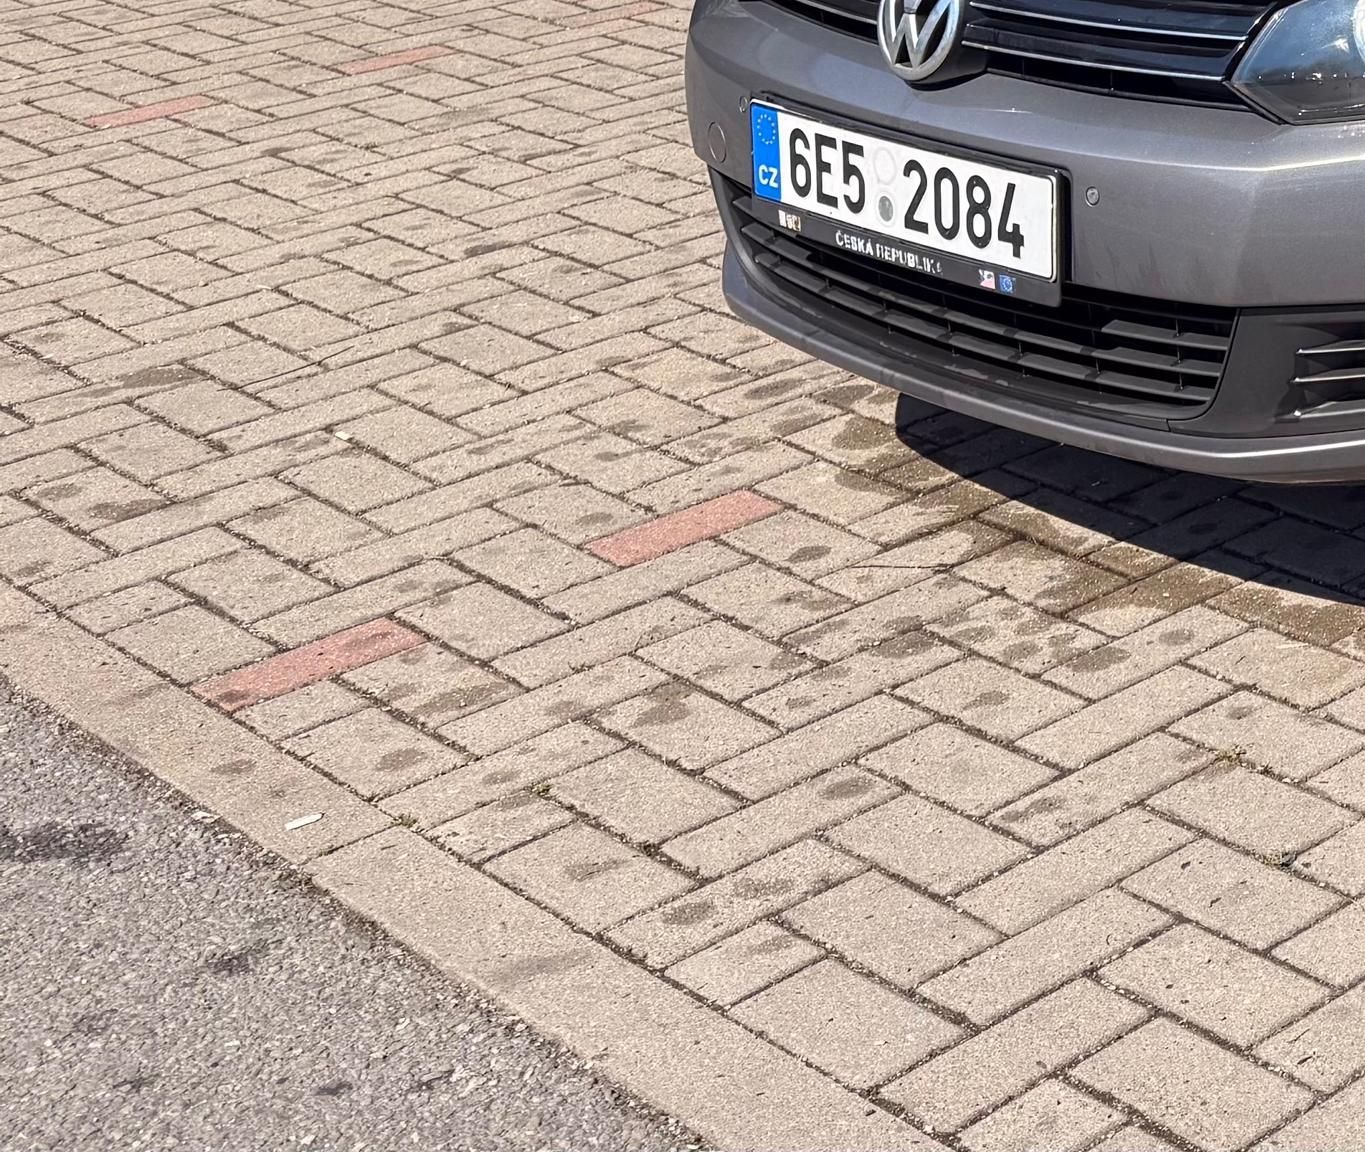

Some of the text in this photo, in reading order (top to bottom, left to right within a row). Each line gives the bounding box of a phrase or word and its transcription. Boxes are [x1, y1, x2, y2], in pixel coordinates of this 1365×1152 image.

[758, 163, 779, 189] CZ
[789, 128, 1025, 259] 6E5 2084
[835, 230, 874, 256] ČESKÁ
